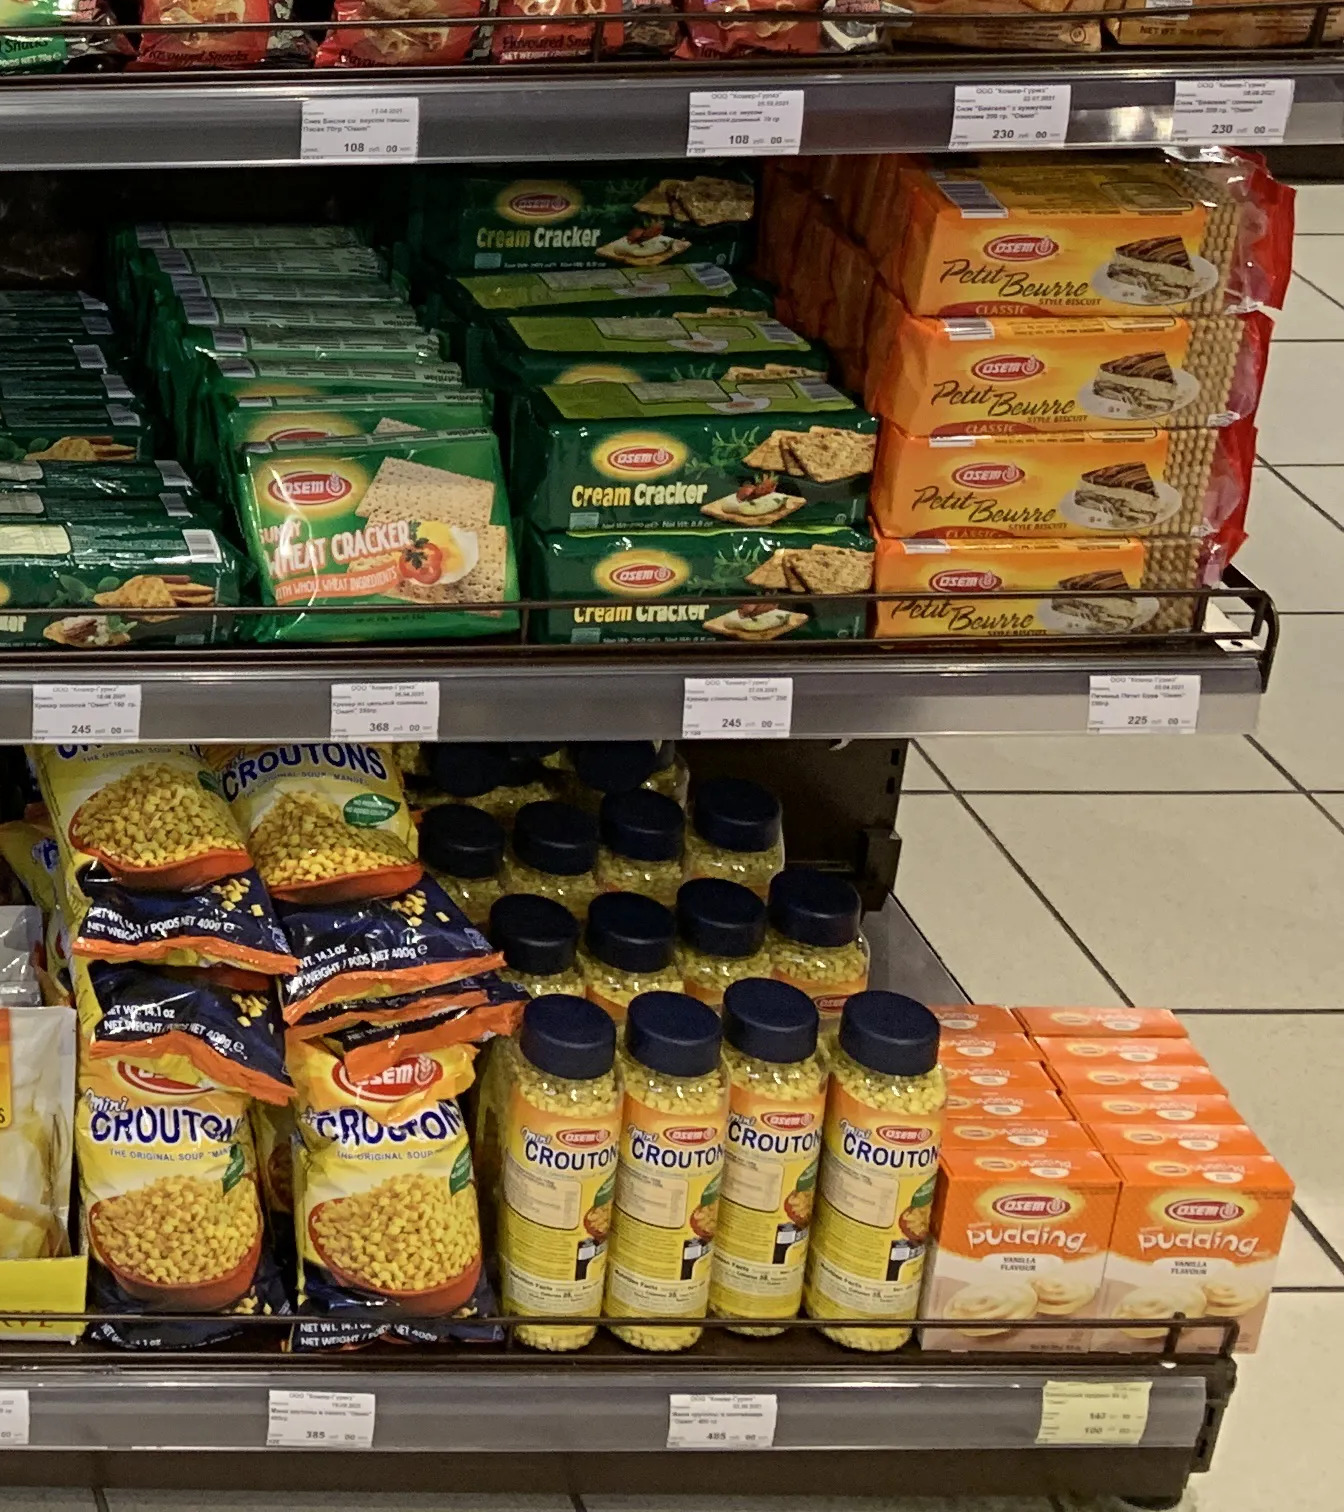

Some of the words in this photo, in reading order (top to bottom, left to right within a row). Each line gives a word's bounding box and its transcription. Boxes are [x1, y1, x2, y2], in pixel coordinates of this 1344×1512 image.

[992, 129, 1013, 139] 230
[940, 258, 1003, 285] Petit
[999, 271, 1089, 298] Beurre
[975, 304, 1027, 315] CLASSIC
[931, 380, 993, 406] Petit
[988, 391, 1076, 417] Beurre
[571, 485, 630, 508] Cream
[634, 483, 708, 505] Cracker
[332, 520, 410, 561] CRACKER
[1128, 716, 1147, 725] 225
[72, 725, 91, 734] 245
[369, 723, 389, 732] 368
[221, 743, 388, 801] CROUTONS
[87, 1092, 129, 1113] mini
[129, 1151, 177, 1161] ORIGINAL
[178, 1151, 204, 1161] SOUP
[967, 1227, 1086, 1251] pudding
[1002, 1256, 1036, 1264] VANILLA
[306, 1431, 325, 1439] 385
